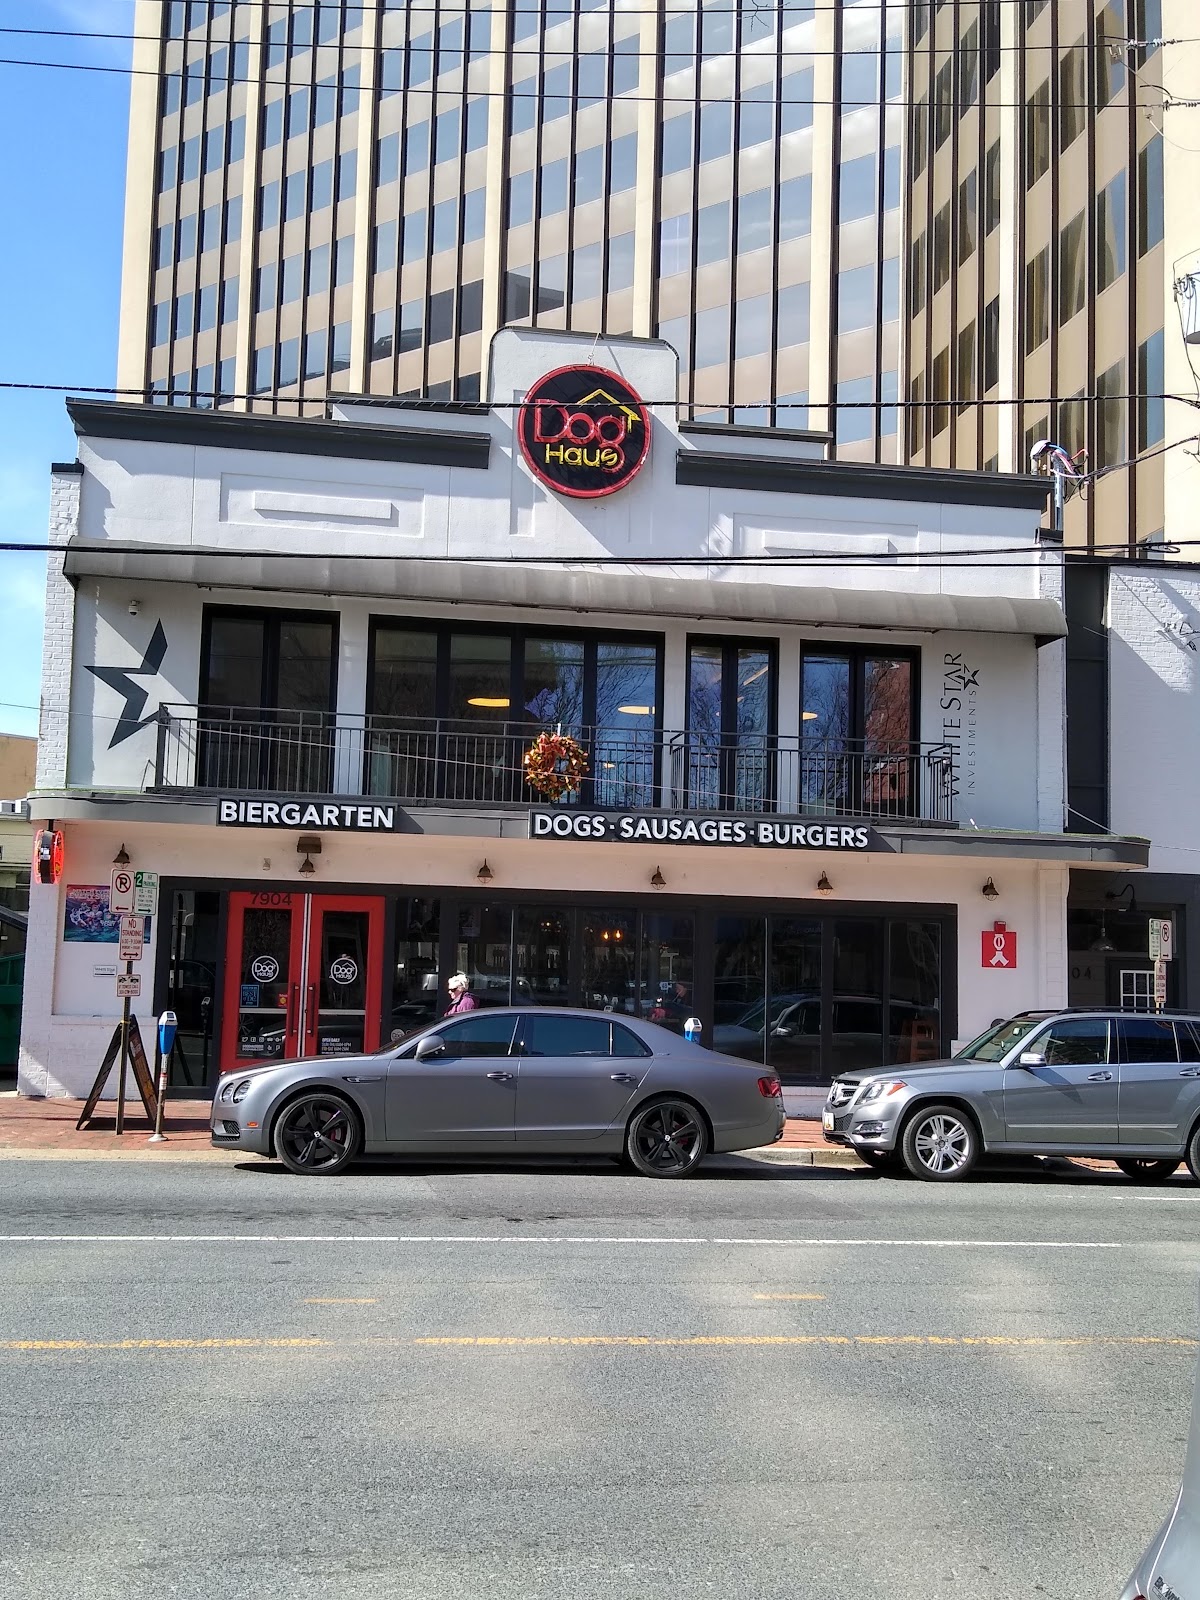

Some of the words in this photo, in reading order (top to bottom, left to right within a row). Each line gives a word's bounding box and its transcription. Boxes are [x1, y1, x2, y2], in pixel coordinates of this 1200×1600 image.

[534, 398, 627, 474] Dog
[545, 443, 619, 468] Haus
[940, 653, 962, 711] STAR
[968, 690, 977, 797] INVESTMENTS
[220, 800, 394, 829] BIERGARTEN
[534, 814, 606, 838] DOGS
[619, 816, 747, 843] SAUSAGES
[757, 822, 869, 848] BURGERS
[136, 874, 143, 886] 2
[250, 891, 292, 906] 7904
[121, 929, 142, 937] STANDING
[128, 919, 137, 928] NO
[255, 963, 274, 973] Dog
[334, 965, 353, 975] Dog
